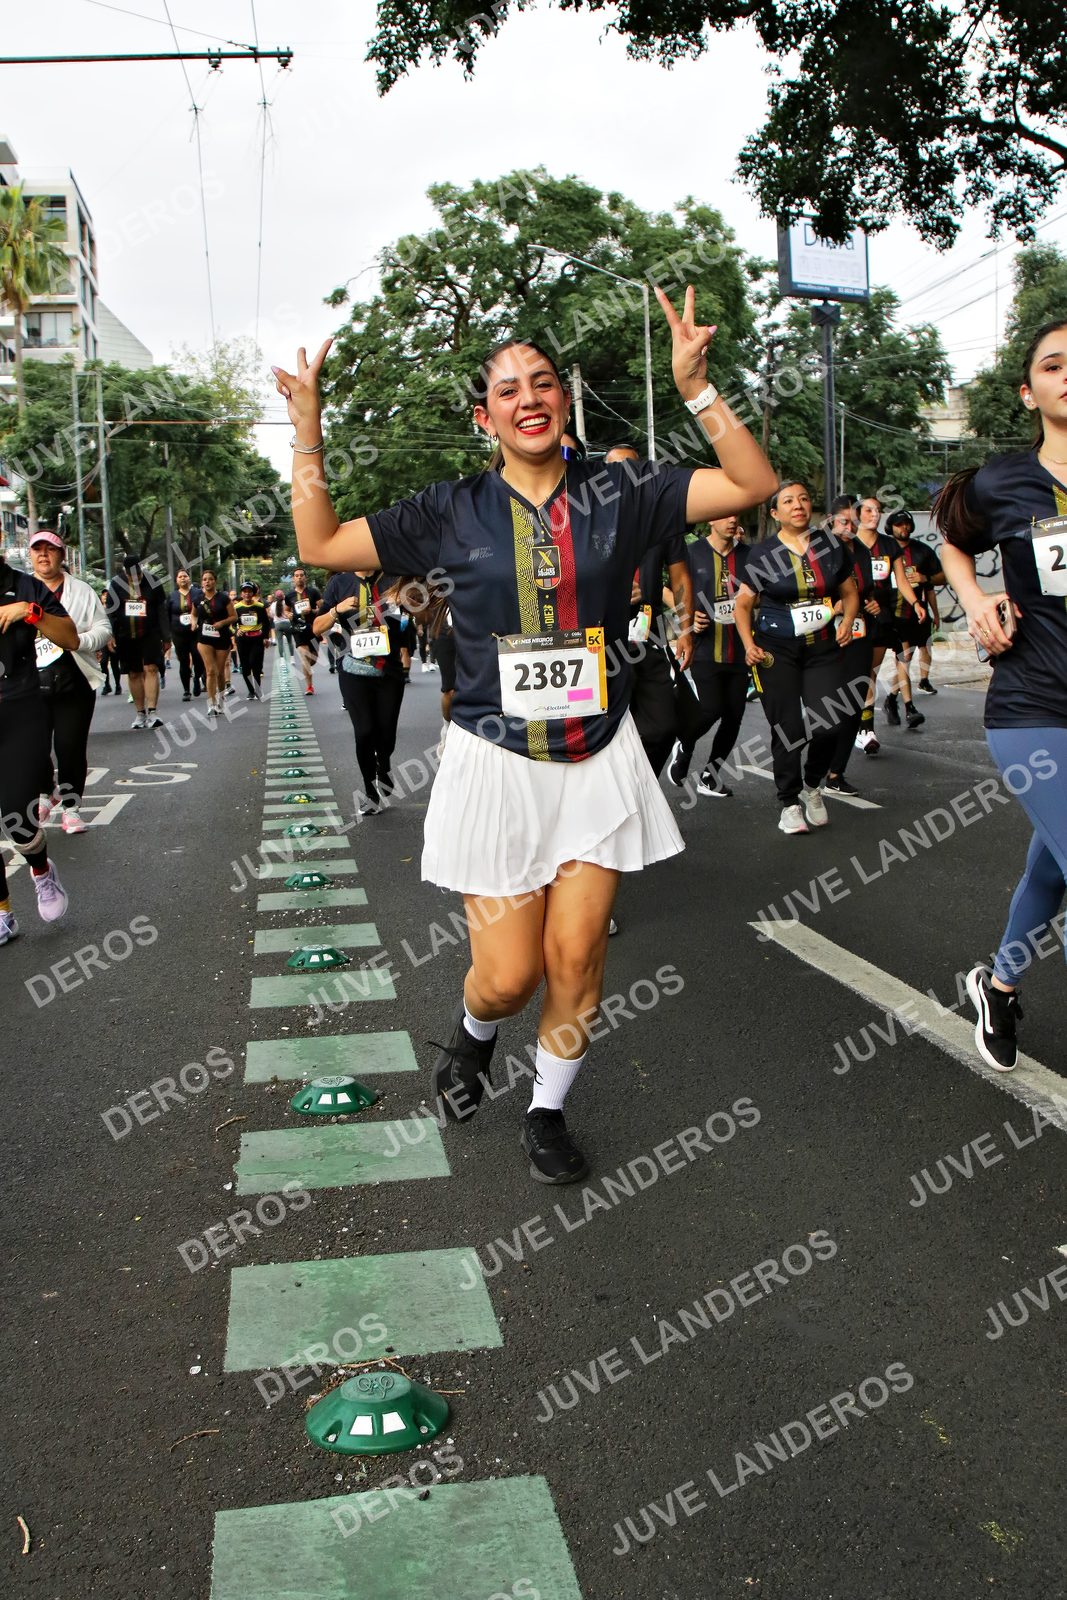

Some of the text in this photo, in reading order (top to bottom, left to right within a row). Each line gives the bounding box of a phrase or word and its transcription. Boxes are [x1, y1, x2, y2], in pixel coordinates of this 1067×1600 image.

[801, 609, 822, 623] 376
[356, 635, 380, 647] 4717
[588, 635, 601, 645] 5K
[514, 658, 584, 692] 2387
